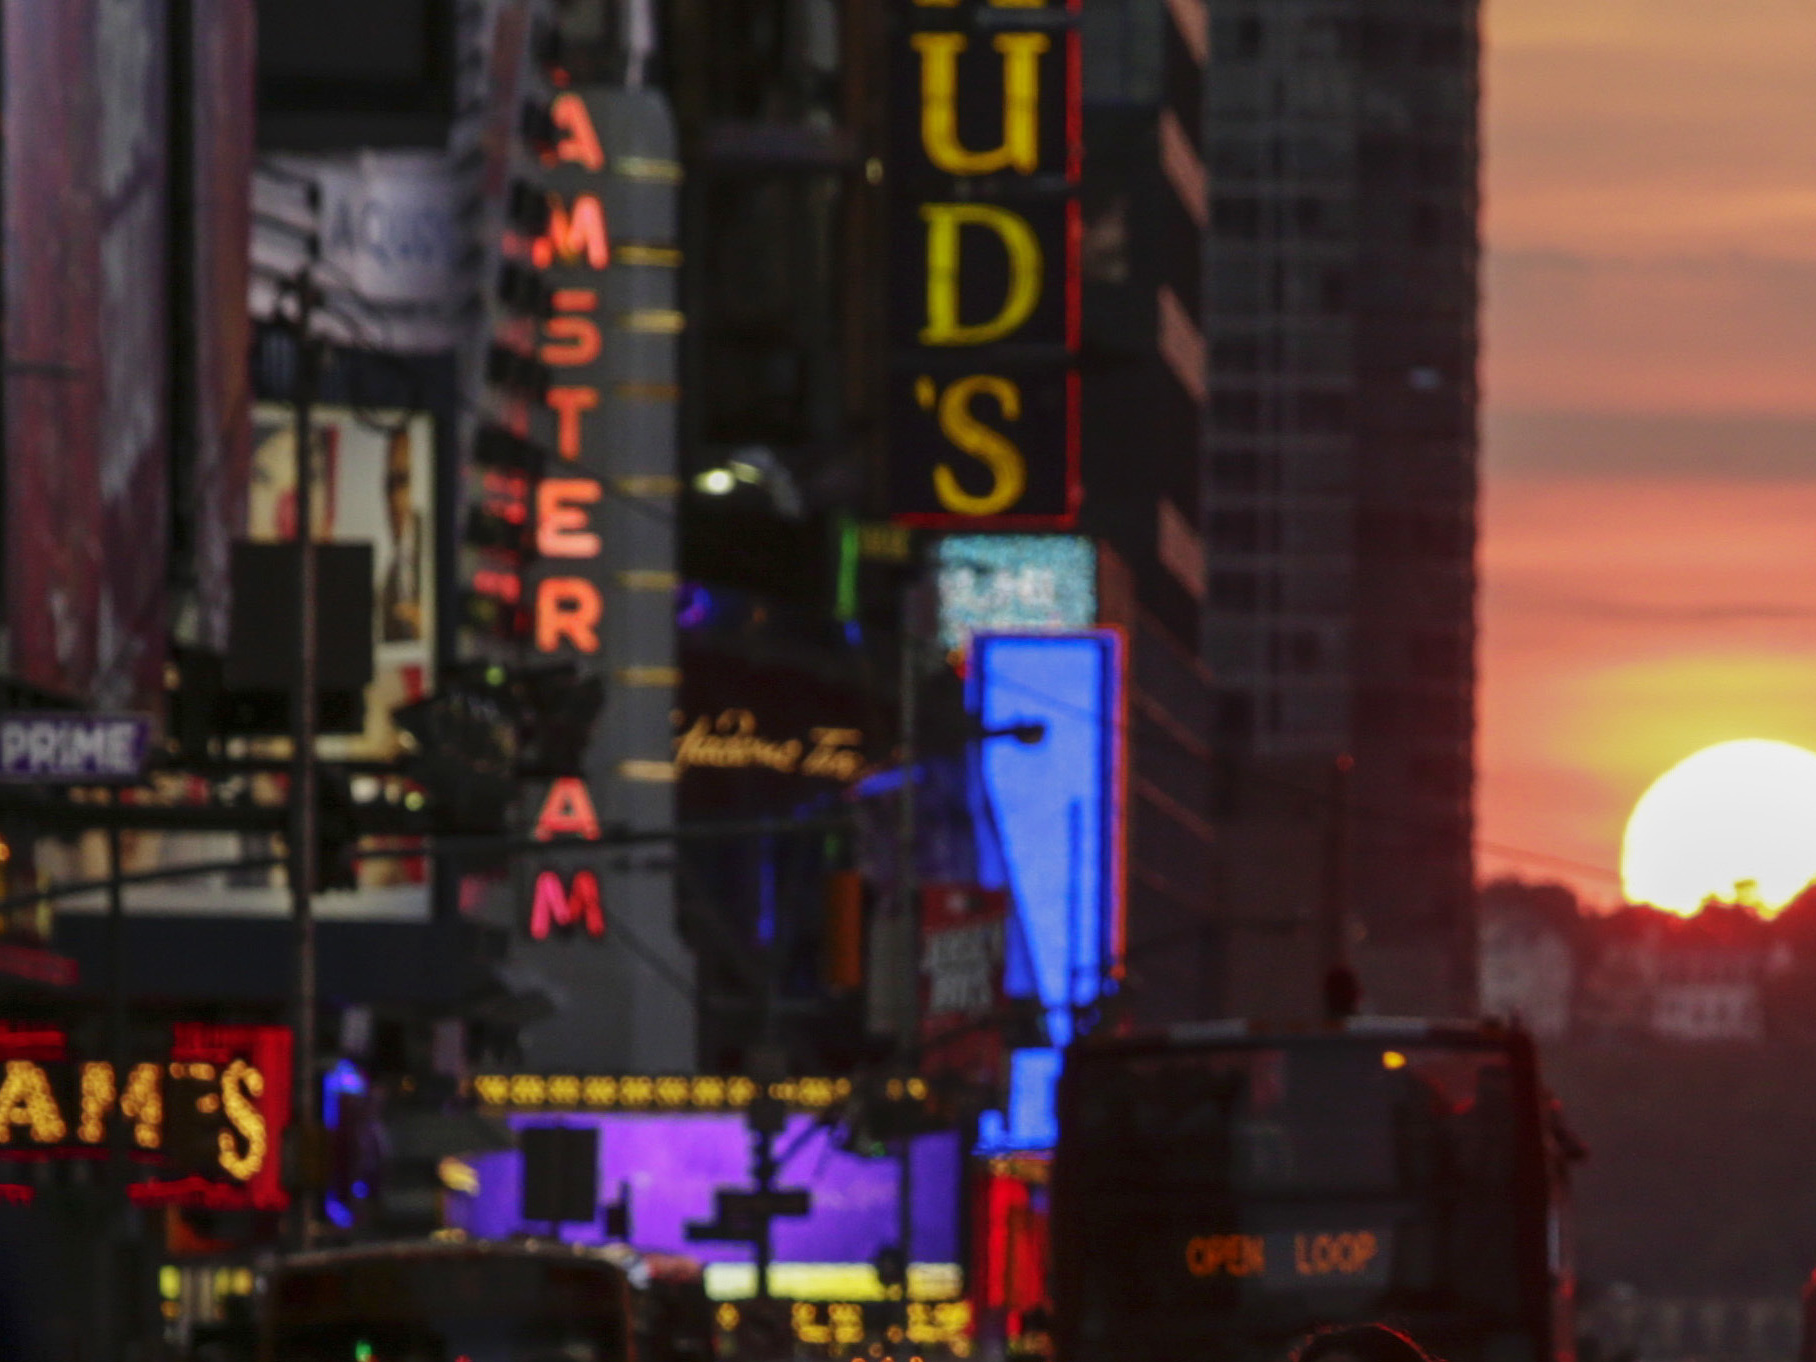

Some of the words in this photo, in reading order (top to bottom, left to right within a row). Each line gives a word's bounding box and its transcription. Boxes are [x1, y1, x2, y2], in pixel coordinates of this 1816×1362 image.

[531, 92, 608, 938] AMSTERAM
[908, 0, 1053, 516] UD'S
[1186, 1234, 1266, 1277] OPEN
[1294, 1230, 1378, 1275] LOOP
